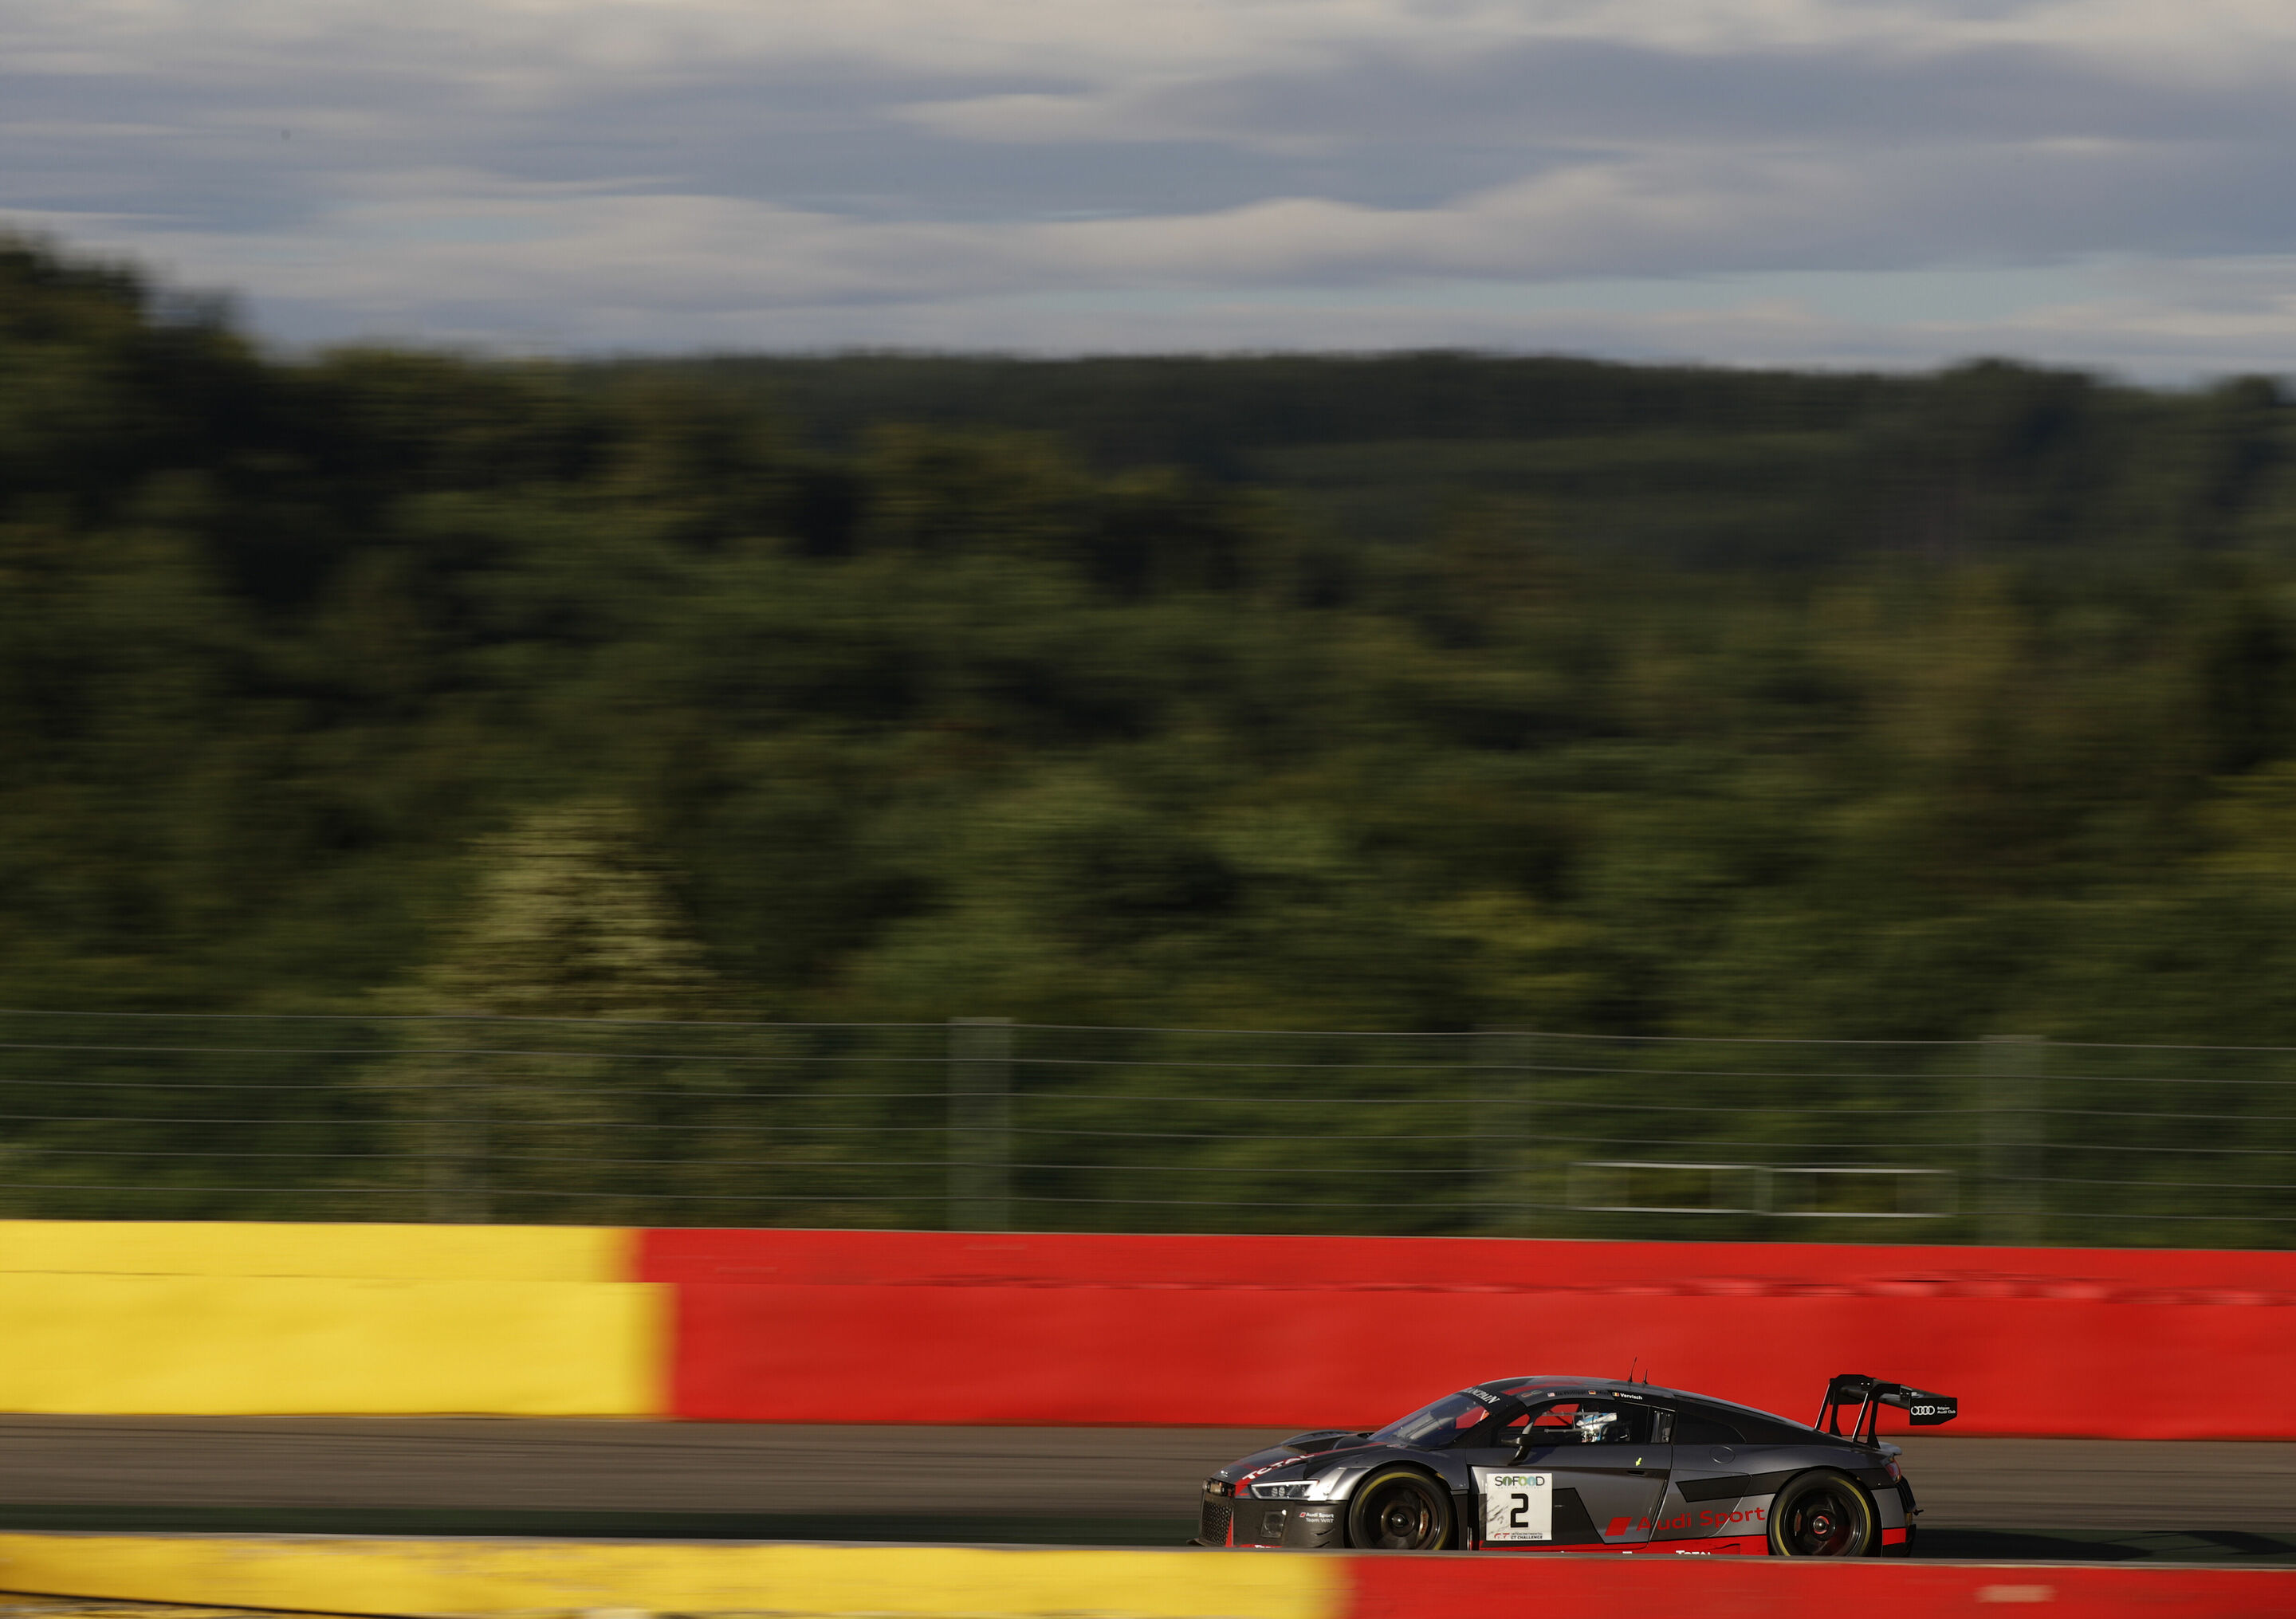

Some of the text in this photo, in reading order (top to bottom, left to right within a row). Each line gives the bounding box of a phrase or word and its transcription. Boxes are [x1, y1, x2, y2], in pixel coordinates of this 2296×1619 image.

[1510, 1493, 1528, 1528] 2
[1636, 1507, 1766, 1531] Audi Sport
